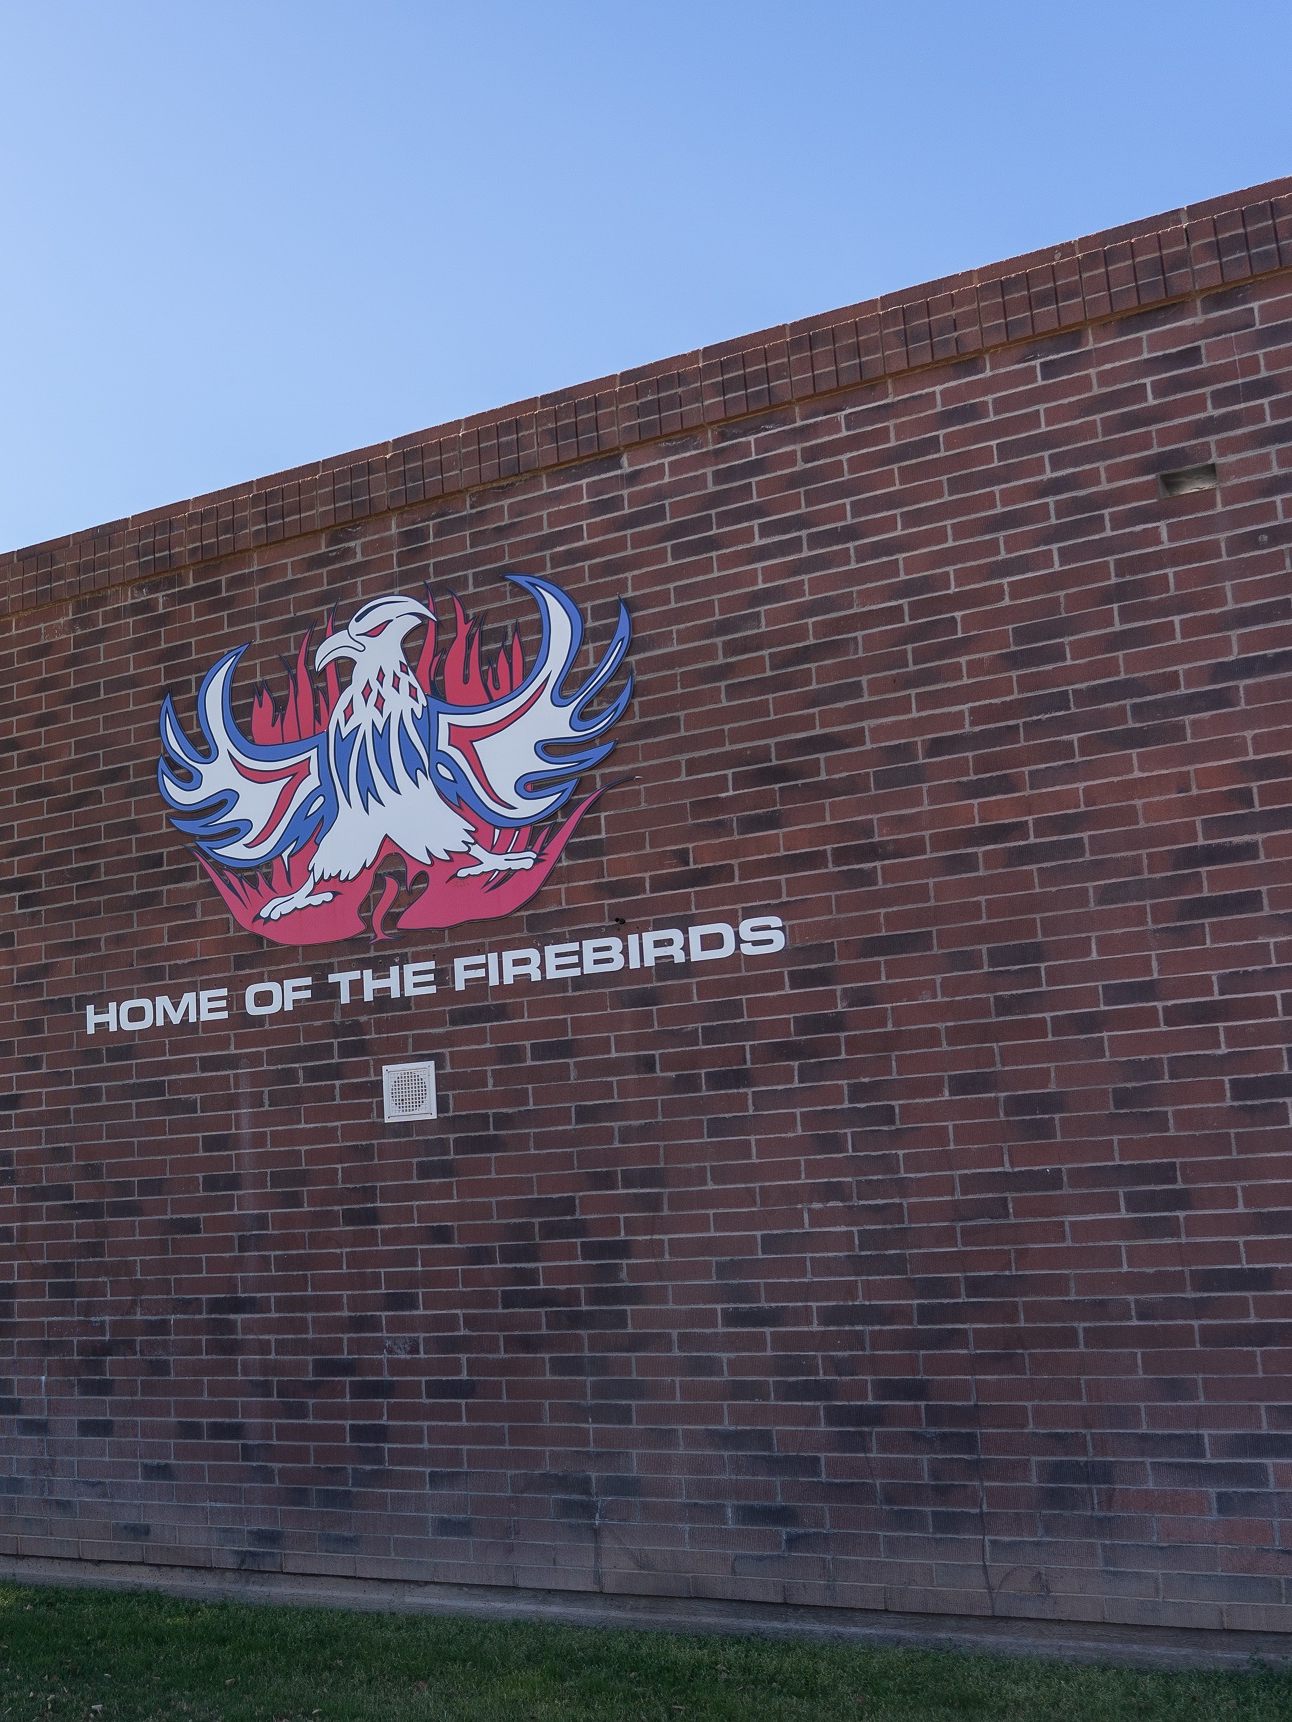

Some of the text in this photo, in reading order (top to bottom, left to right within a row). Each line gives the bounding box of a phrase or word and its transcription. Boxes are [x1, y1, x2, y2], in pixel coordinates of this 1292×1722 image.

[86, 915, 787, 1034] HOME OF THE FIREBIRDS
